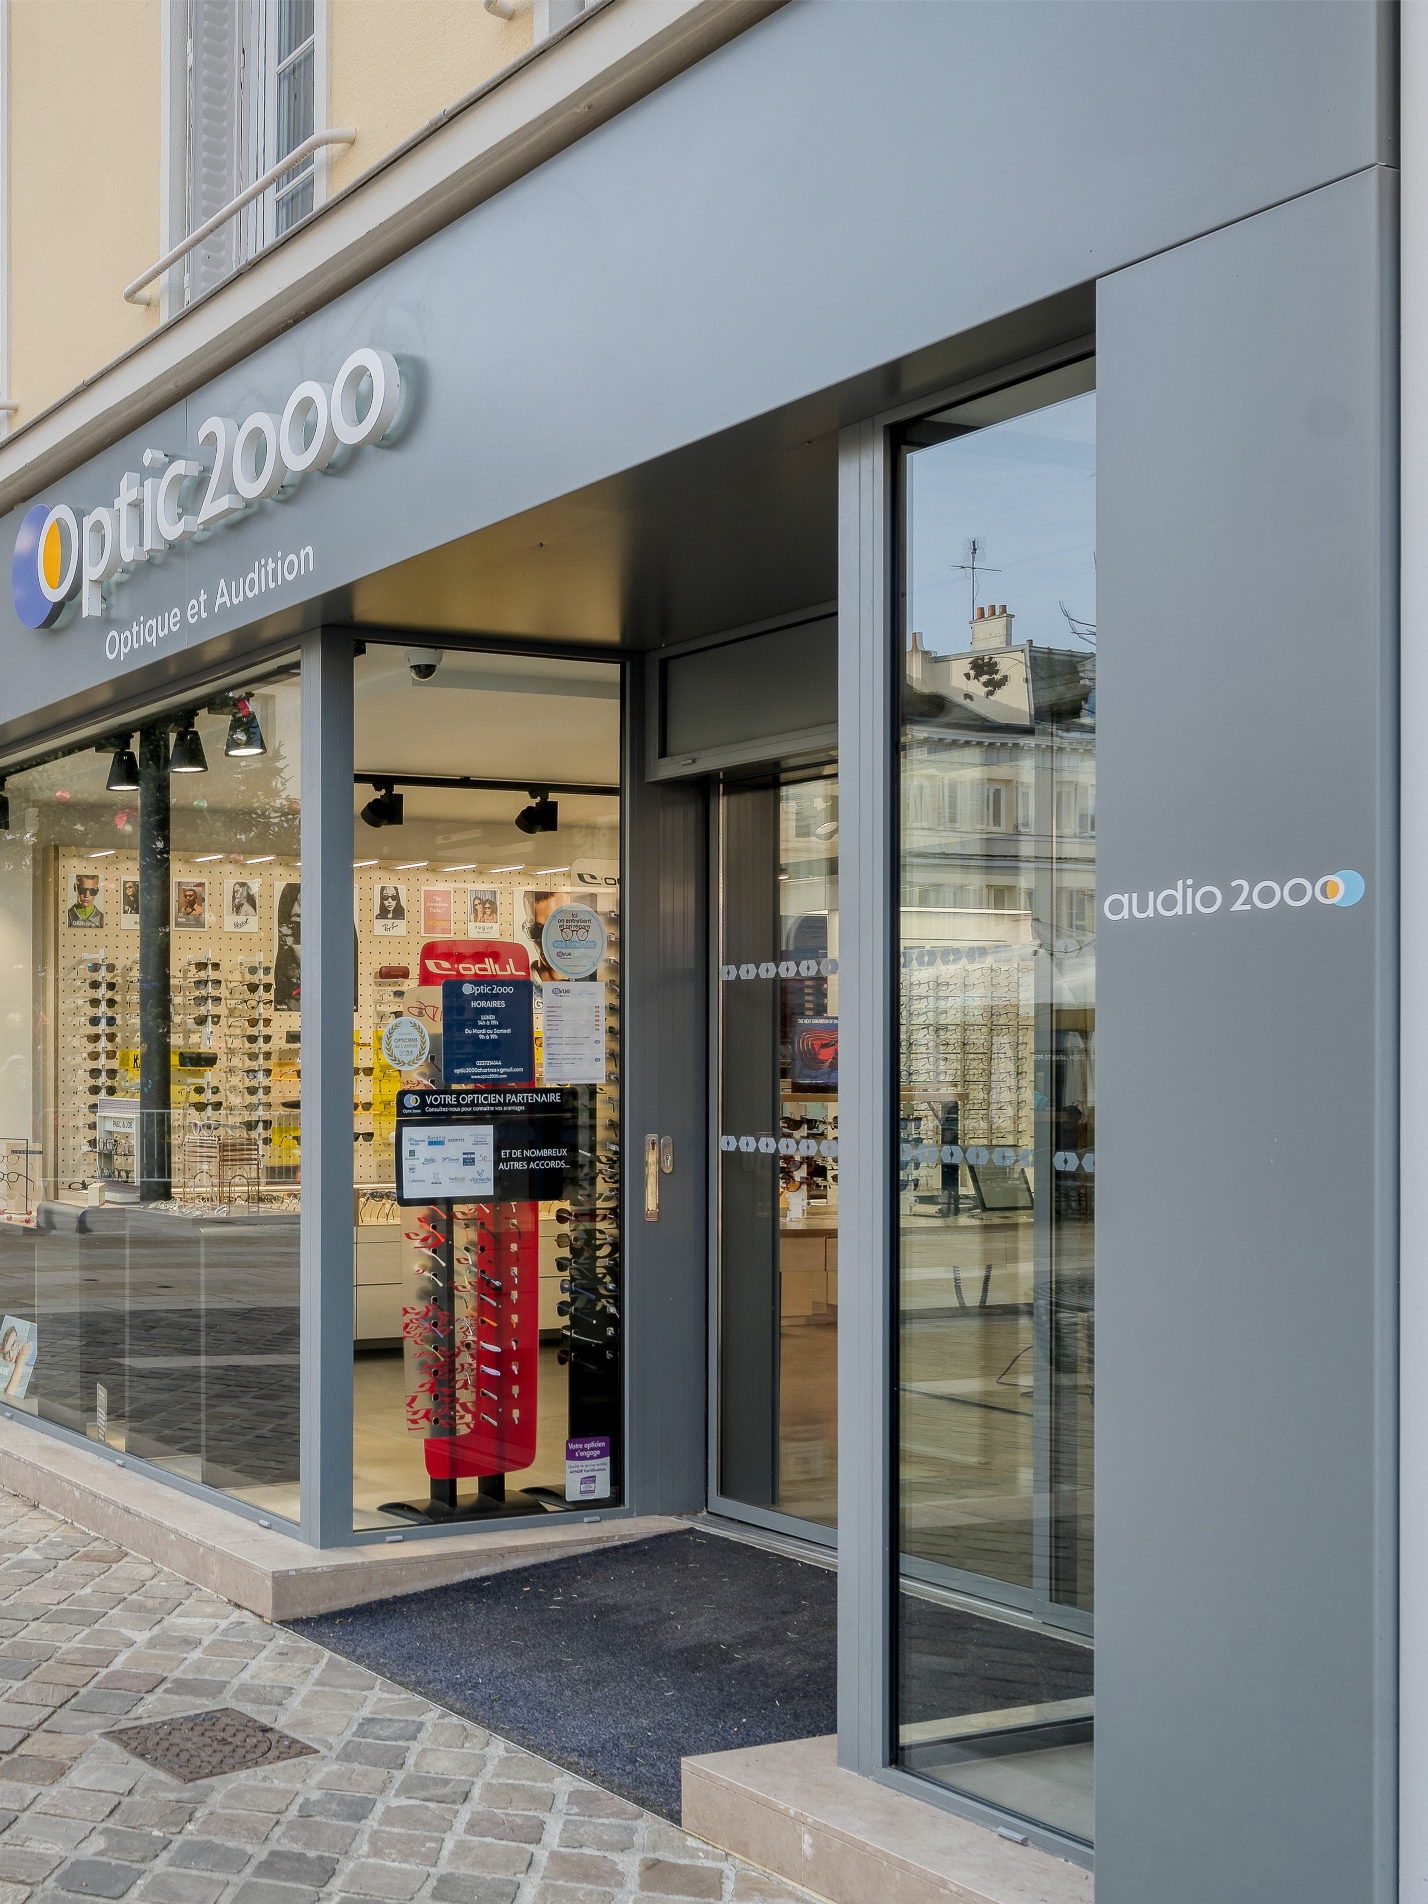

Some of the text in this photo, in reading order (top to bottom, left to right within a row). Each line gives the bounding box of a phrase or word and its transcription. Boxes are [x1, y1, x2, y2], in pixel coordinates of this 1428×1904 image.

[37, 347, 400, 619] Optic 2000
[105, 545, 314, 661] Optique et Audition
[1103, 873, 1347, 921] audio 2000
[492, 985, 514, 994] 2000
[425, 1093, 561, 1105] VOTRE OPTICIEN PARTENAIRE
[501, 1148, 568, 1158] ET DE NOMBREUX
[498, 1161, 528, 1170] AUTRES
[568, 1440, 606, 1450] Votre opticien
